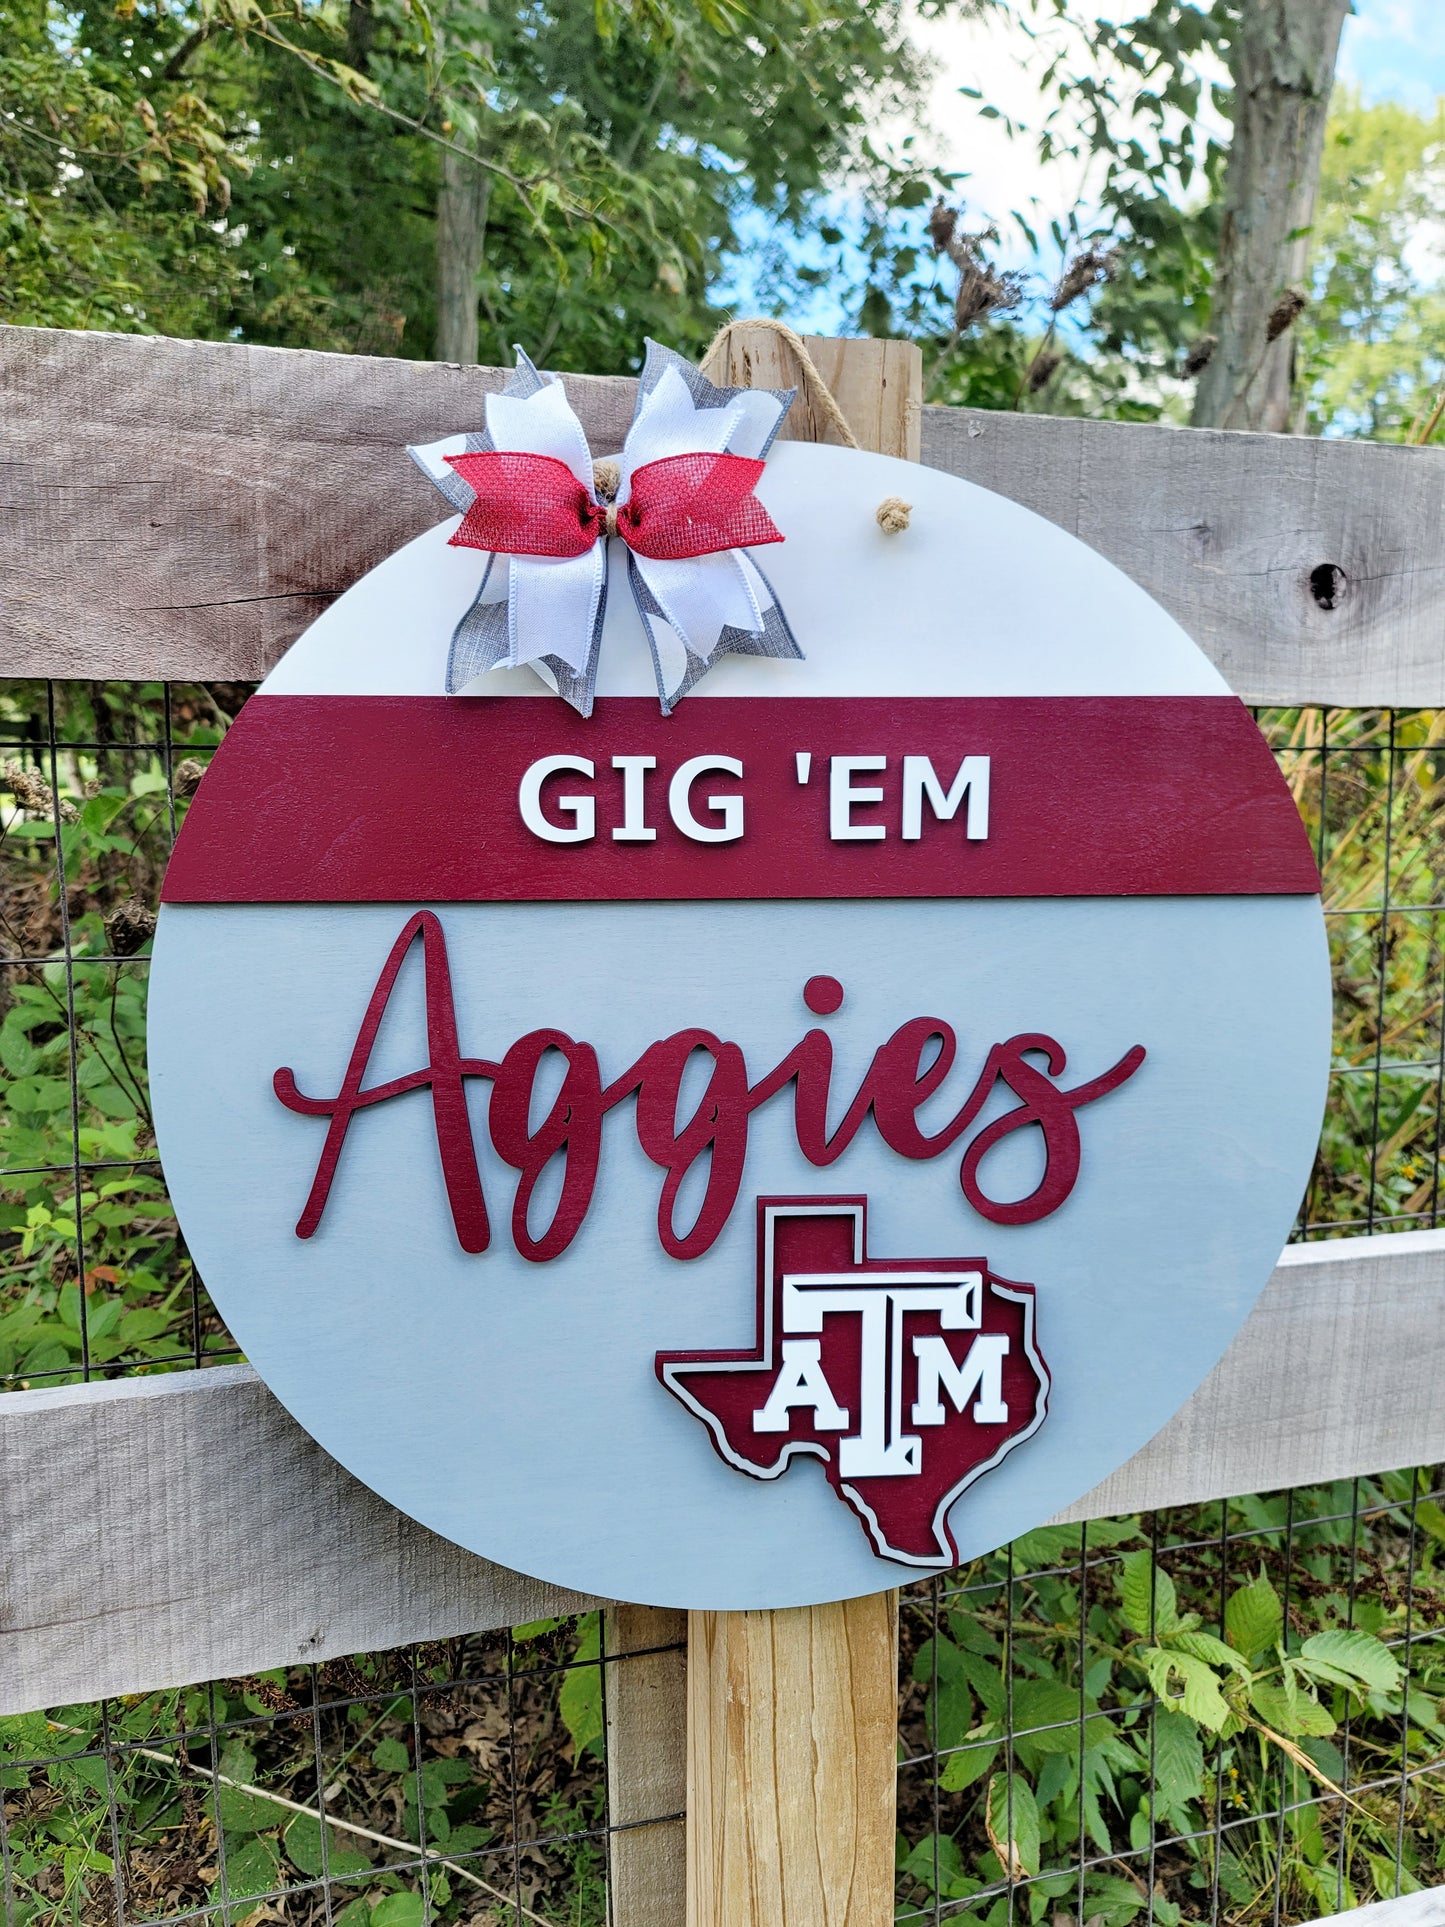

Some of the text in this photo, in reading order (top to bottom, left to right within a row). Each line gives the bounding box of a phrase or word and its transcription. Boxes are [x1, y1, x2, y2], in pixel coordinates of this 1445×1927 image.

[518, 752, 991, 843] GIG 'EM
[273, 909, 1147, 1263] Aggies
